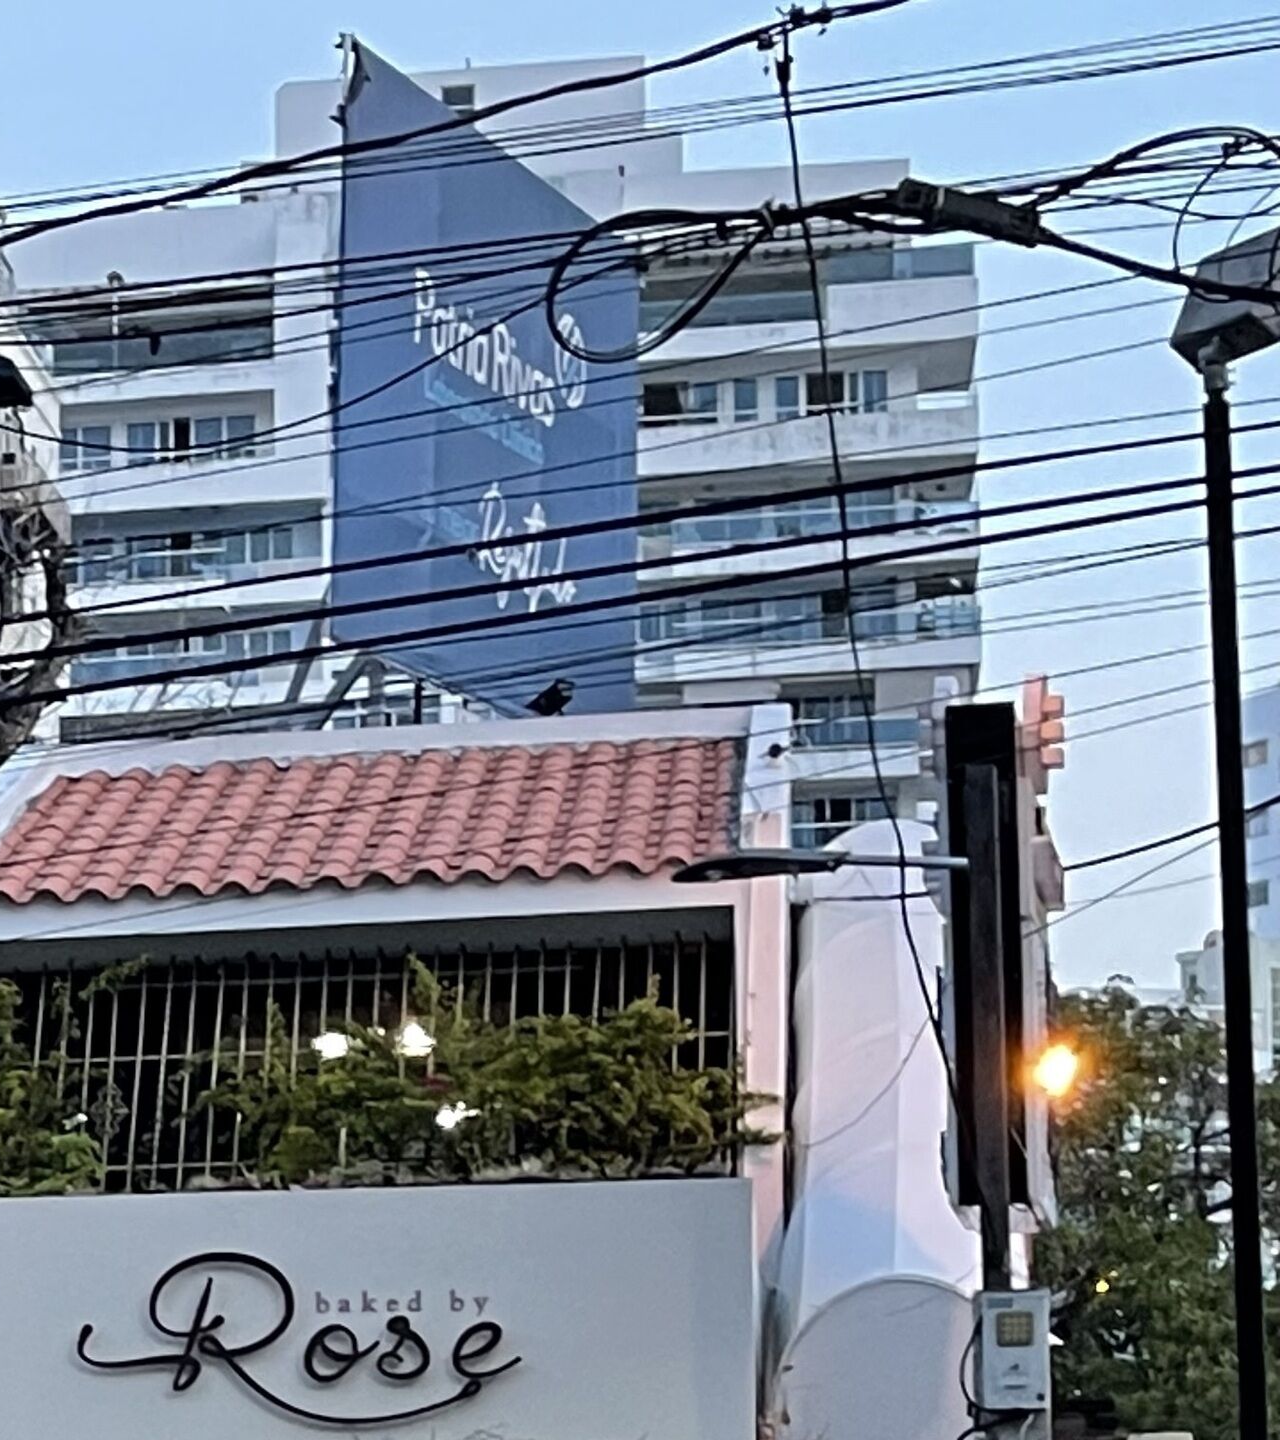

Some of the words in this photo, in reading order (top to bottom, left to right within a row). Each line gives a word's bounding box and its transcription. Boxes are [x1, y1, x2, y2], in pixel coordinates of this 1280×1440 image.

[77, 1250, 523, 1426] Rose
[314, 1290, 424, 1315] baked
[448, 1289, 491, 1317] by
